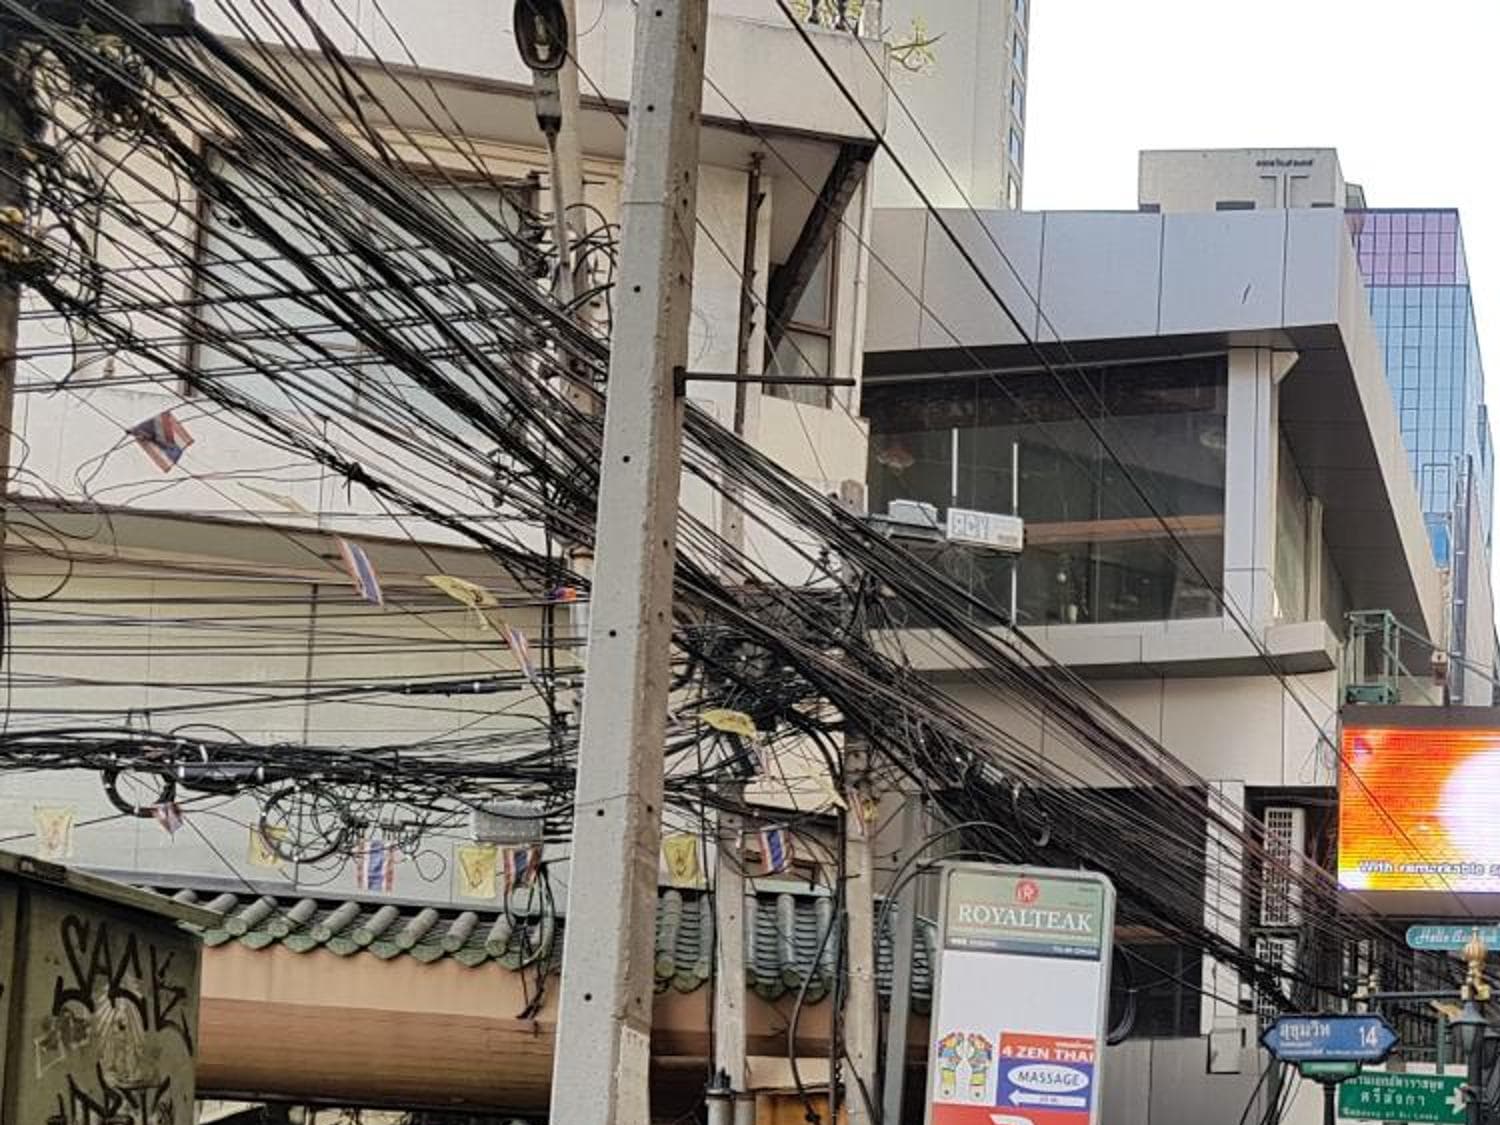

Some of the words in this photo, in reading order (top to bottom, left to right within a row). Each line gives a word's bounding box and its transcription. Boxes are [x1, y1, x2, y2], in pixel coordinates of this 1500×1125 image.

[959, 904, 1093, 932] ROYALTEAK
[1359, 1026, 1378, 1048] 14
[1017, 1046, 1049, 1060] ZEN
[1017, 1071, 1081, 1087] MASSAGE
